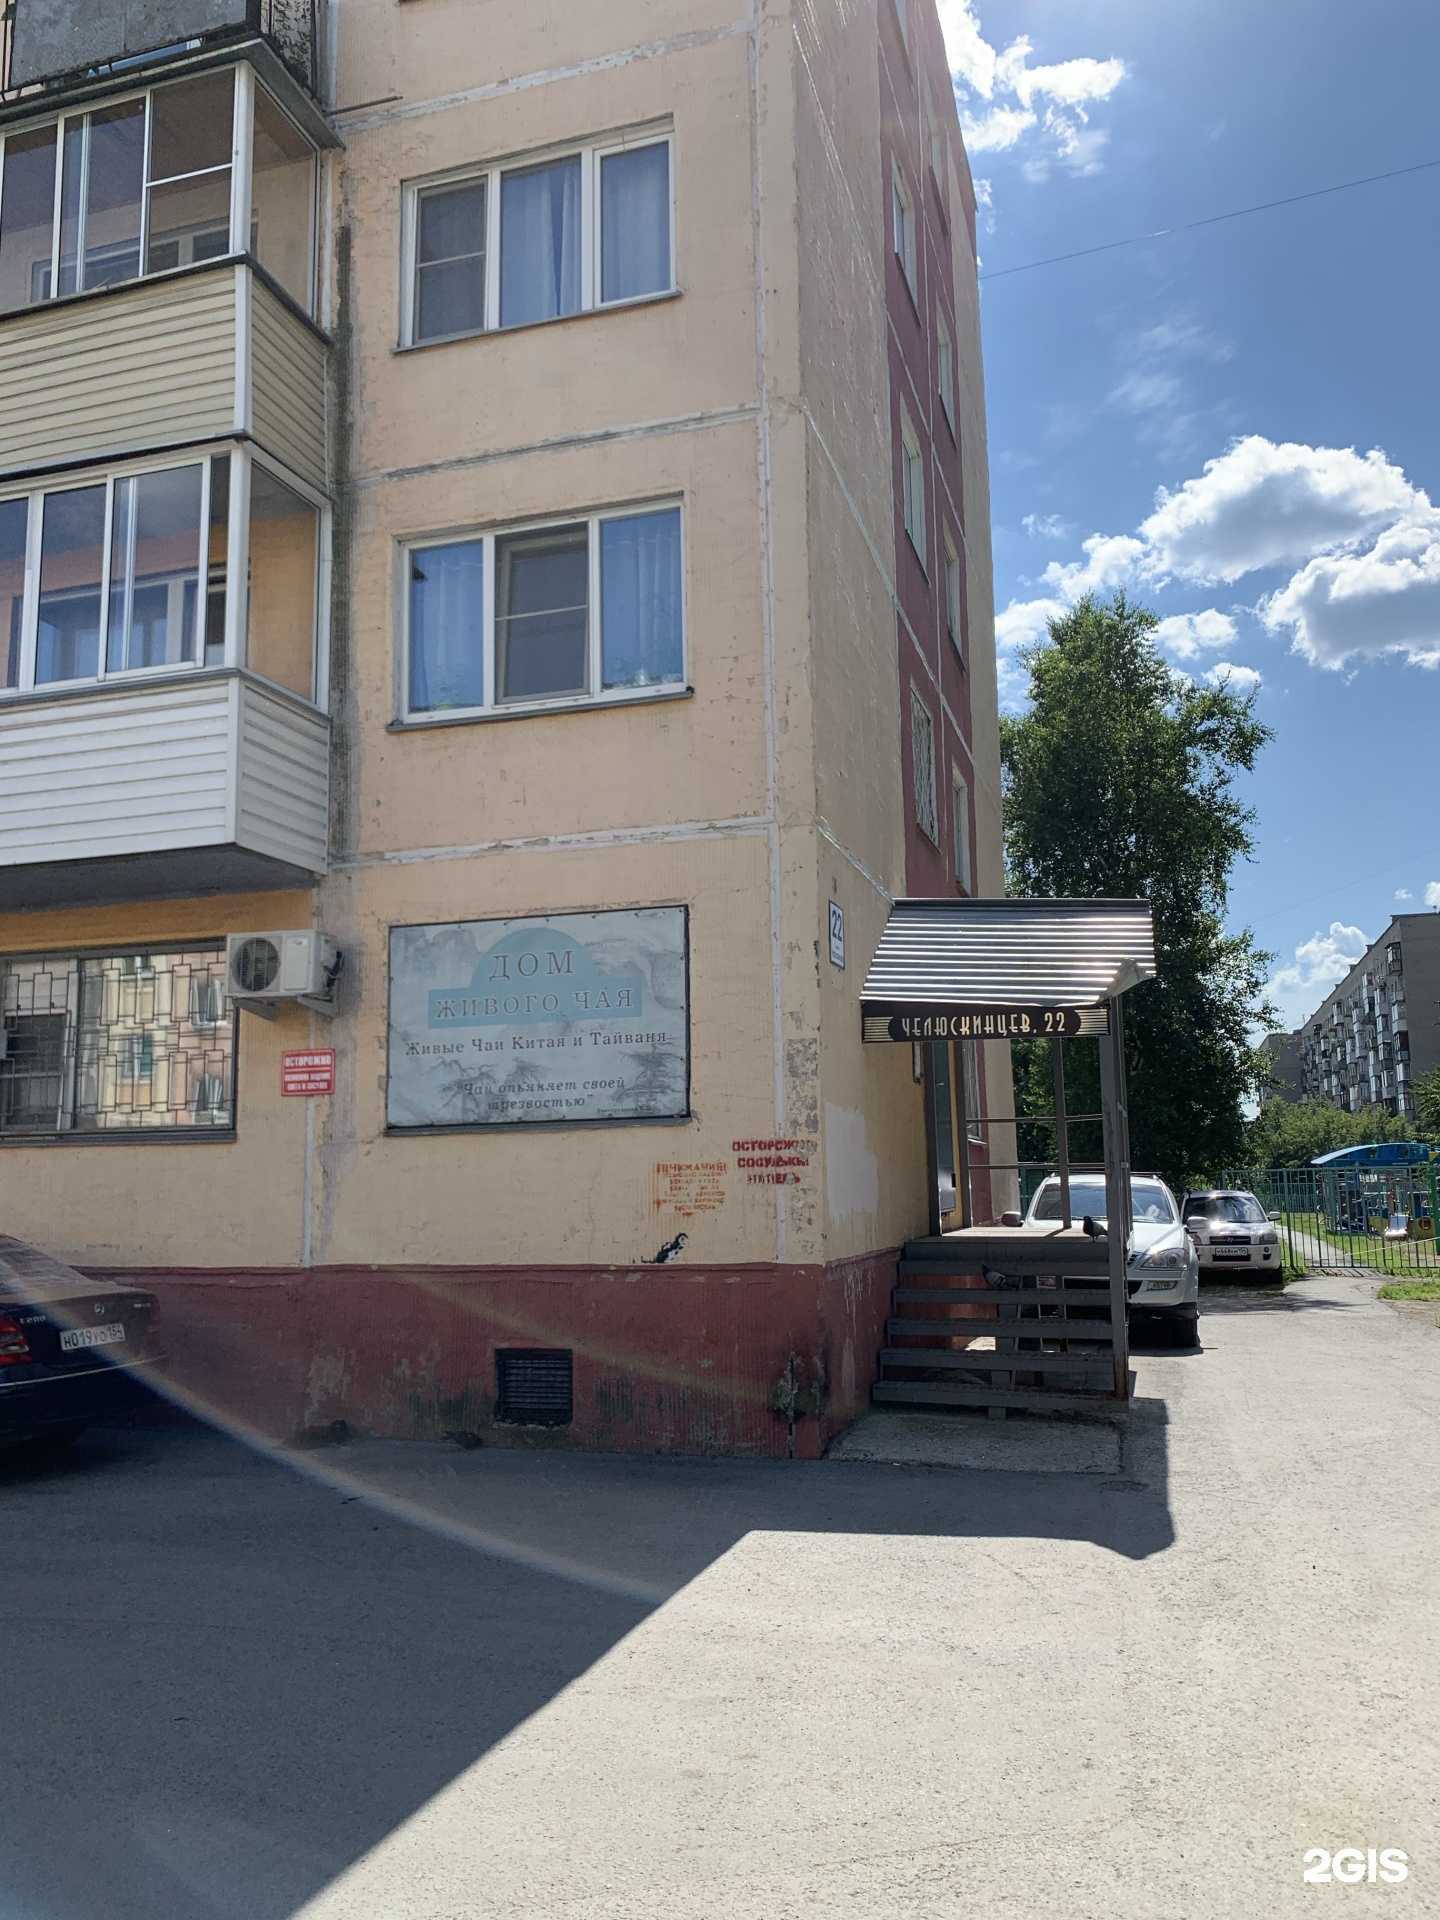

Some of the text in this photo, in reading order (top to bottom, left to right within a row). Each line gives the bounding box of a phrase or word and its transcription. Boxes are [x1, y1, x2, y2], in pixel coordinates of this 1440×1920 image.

[832, 910, 842, 942] 22
[489, 950, 576, 982] ДОМ
[437, 989, 633, 1018] ЖИВОГО ЧАЯ
[1044, 1012, 1065, 1032] 22
[405, 1042, 465, 1056] Живые
[512, 1036, 566, 1050] Китая
[573, 1036, 583, 1047] и
[590, 1032, 666, 1046] Тайваня
[583, 1077, 625, 1090] своей
